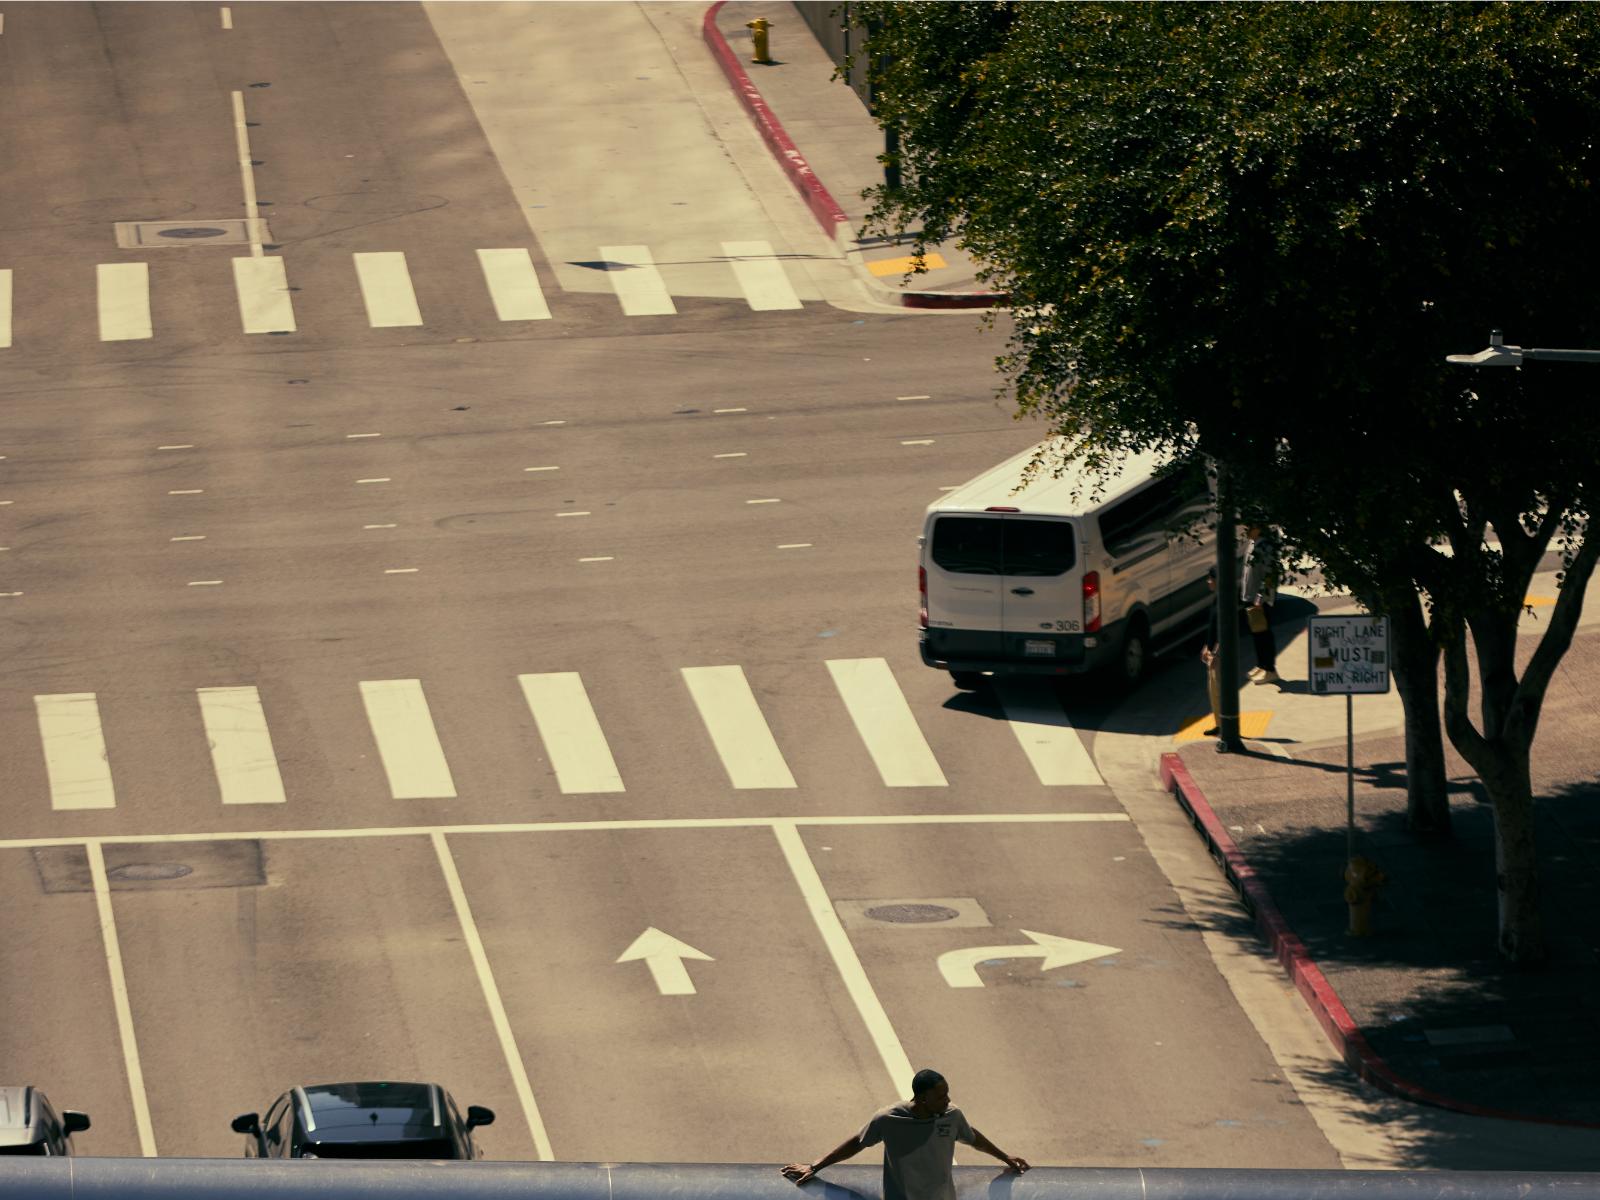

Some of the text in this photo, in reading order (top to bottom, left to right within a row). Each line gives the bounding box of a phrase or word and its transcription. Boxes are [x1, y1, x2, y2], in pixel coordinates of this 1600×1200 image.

[1056, 620, 1080, 631] 306
[1313, 625, 1384, 638] RIGHT LANE
[1328, 647, 1370, 662] MUST
[1313, 671, 1385, 684] TURN RIGHT
